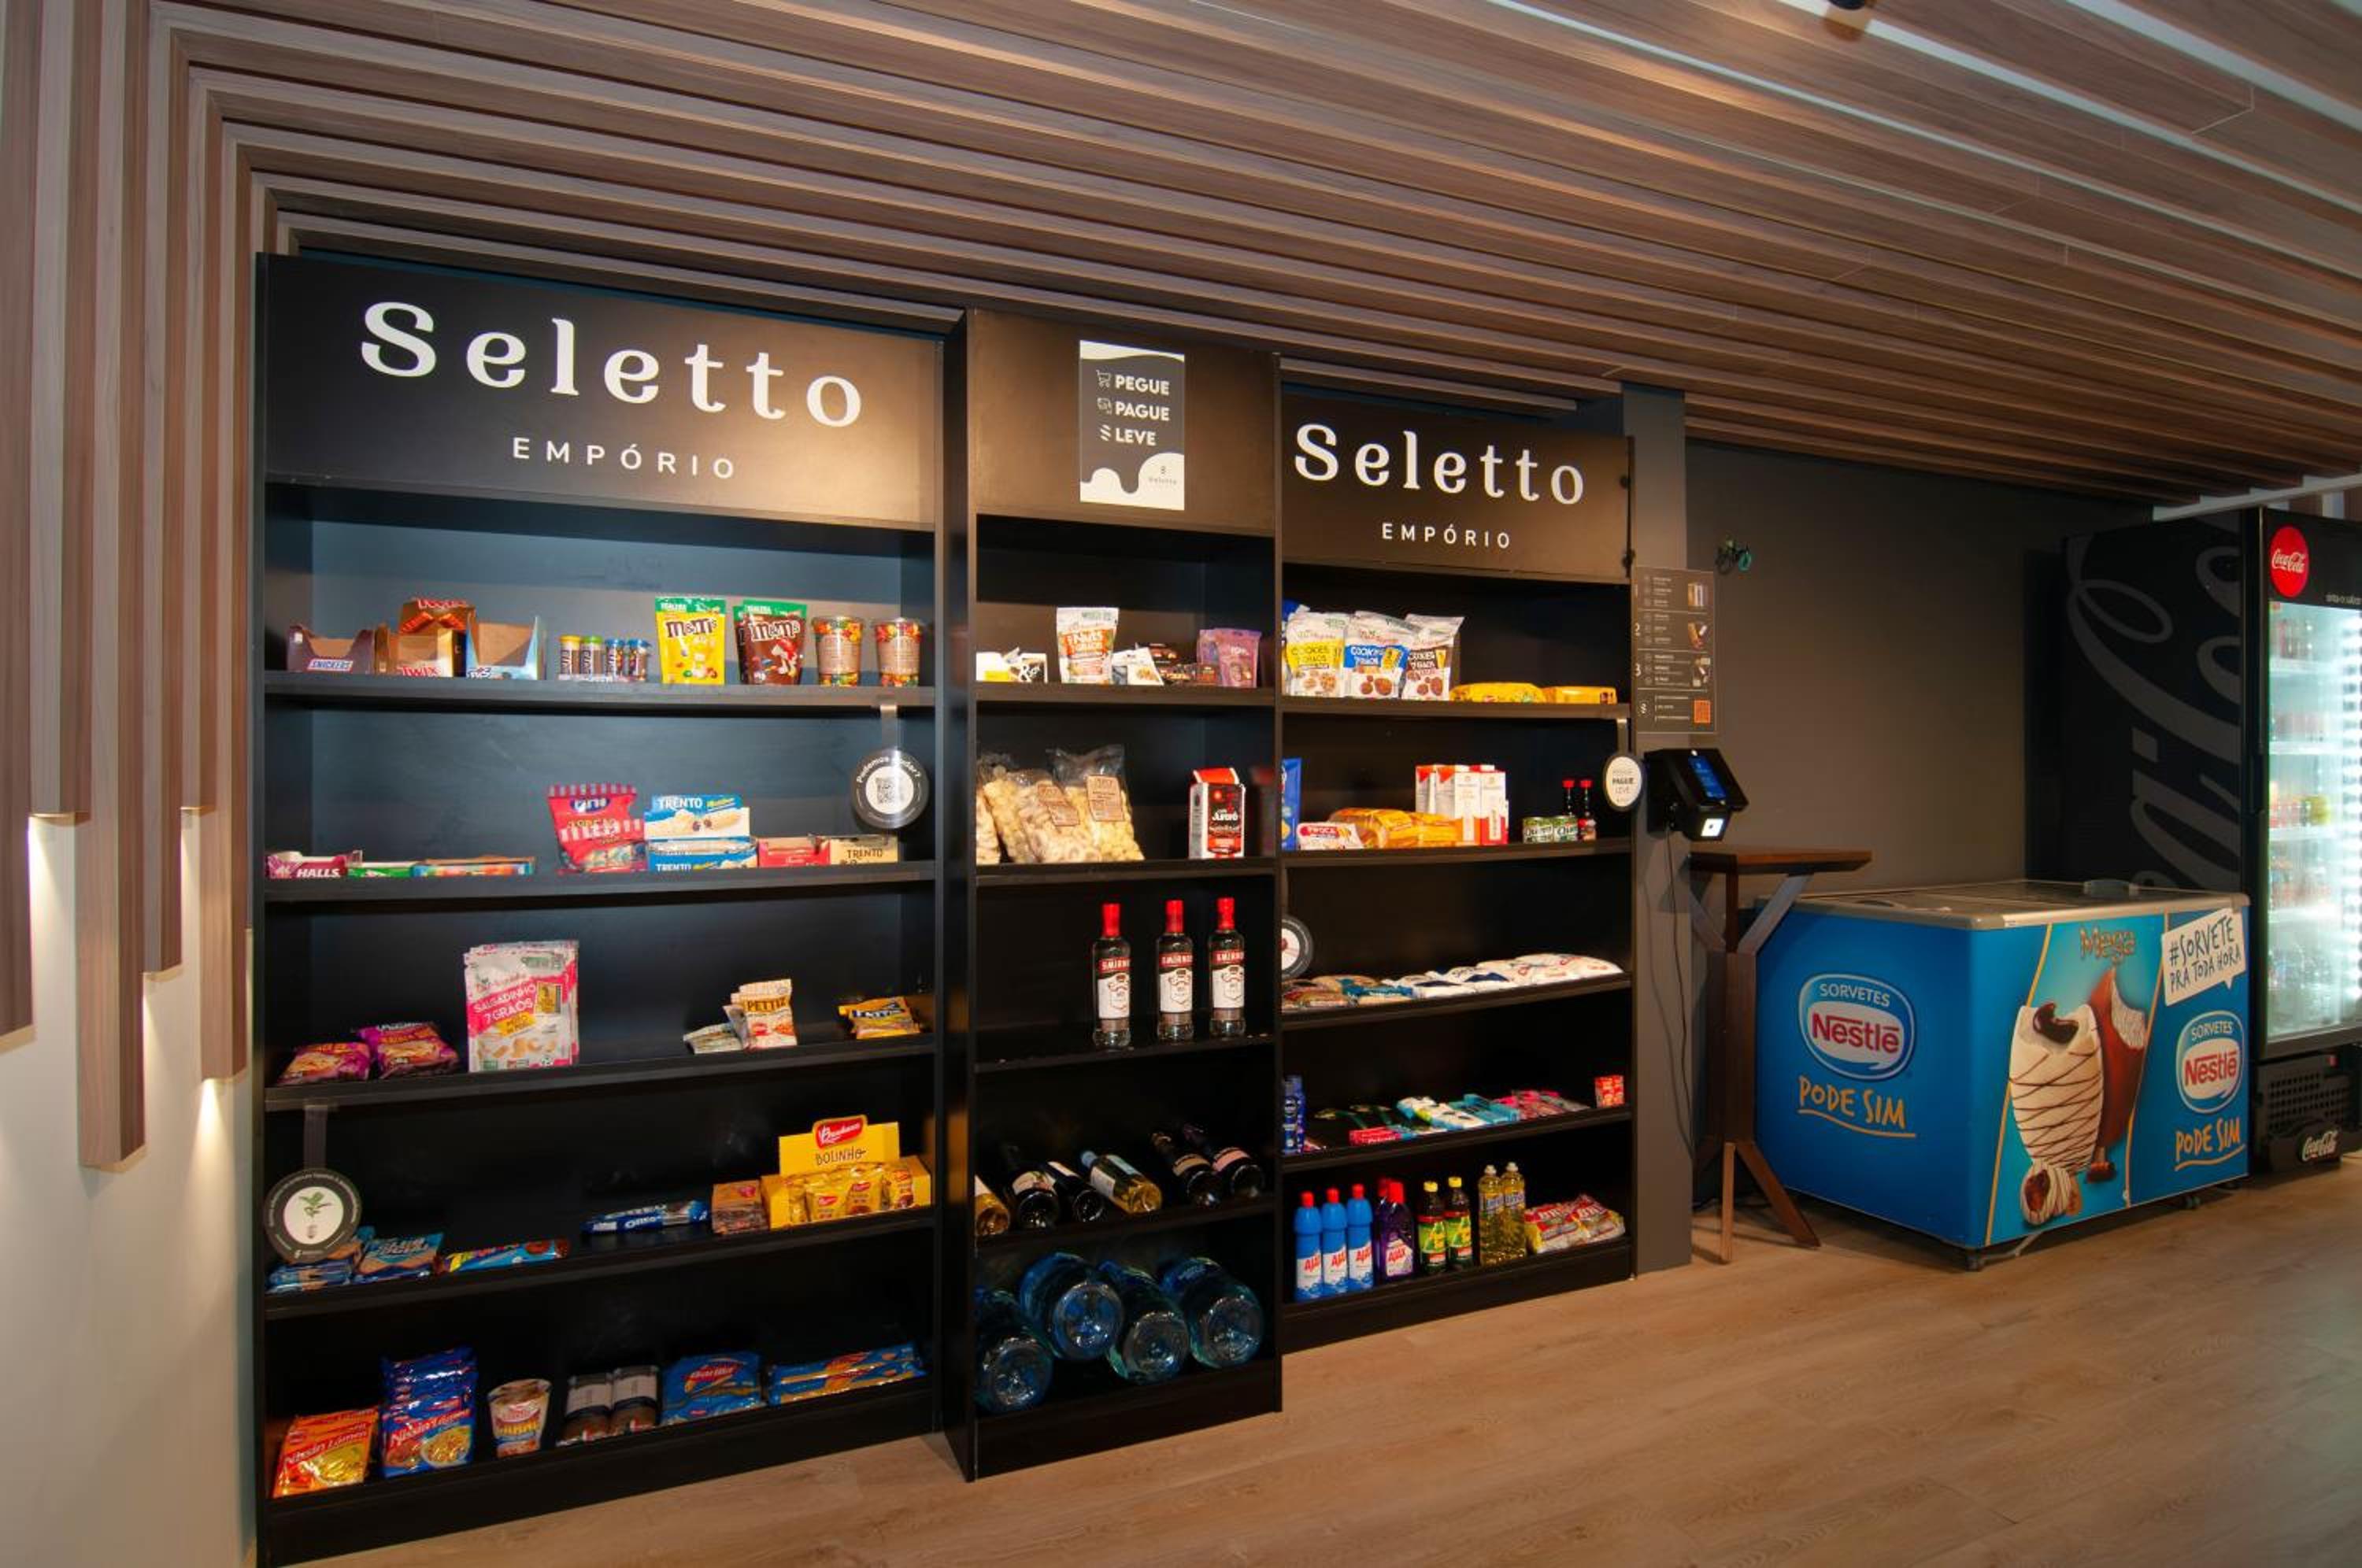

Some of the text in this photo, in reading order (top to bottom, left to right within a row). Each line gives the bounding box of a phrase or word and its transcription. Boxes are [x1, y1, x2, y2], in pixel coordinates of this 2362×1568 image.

[361, 301, 862, 427] Seletto
[1115, 374, 1170, 395] PEGUE
[1115, 401, 1170, 422] PAGUE
[1115, 427, 1157, 446] LEVE
[512, 436, 735, 479] EMPÓRIO
[1294, 423, 1584, 505] Seletto
[1381, 522, 1511, 549] EMPÓRIO
[659, 797, 703, 809] TRENTO
[847, 848, 883, 859] TRENTO
[297, 867, 341, 878] HALLS
[2169, 915, 2234, 966] #SORVETE
[2169, 947, 2242, 994] PRA TODA HORA
[1819, 983, 1891, 1008] SORVETES
[1811, 1013, 1899, 1053] Nestlé
[2191, 1020, 2234, 1041] SORVETES
[2183, 1050, 2238, 1086] Nestlé
[1798, 1074, 1905, 1130] PODE SIM
[2175, 1117, 2241, 1162] PODE SIM
[815, 1145, 867, 1166] BOLINHO
